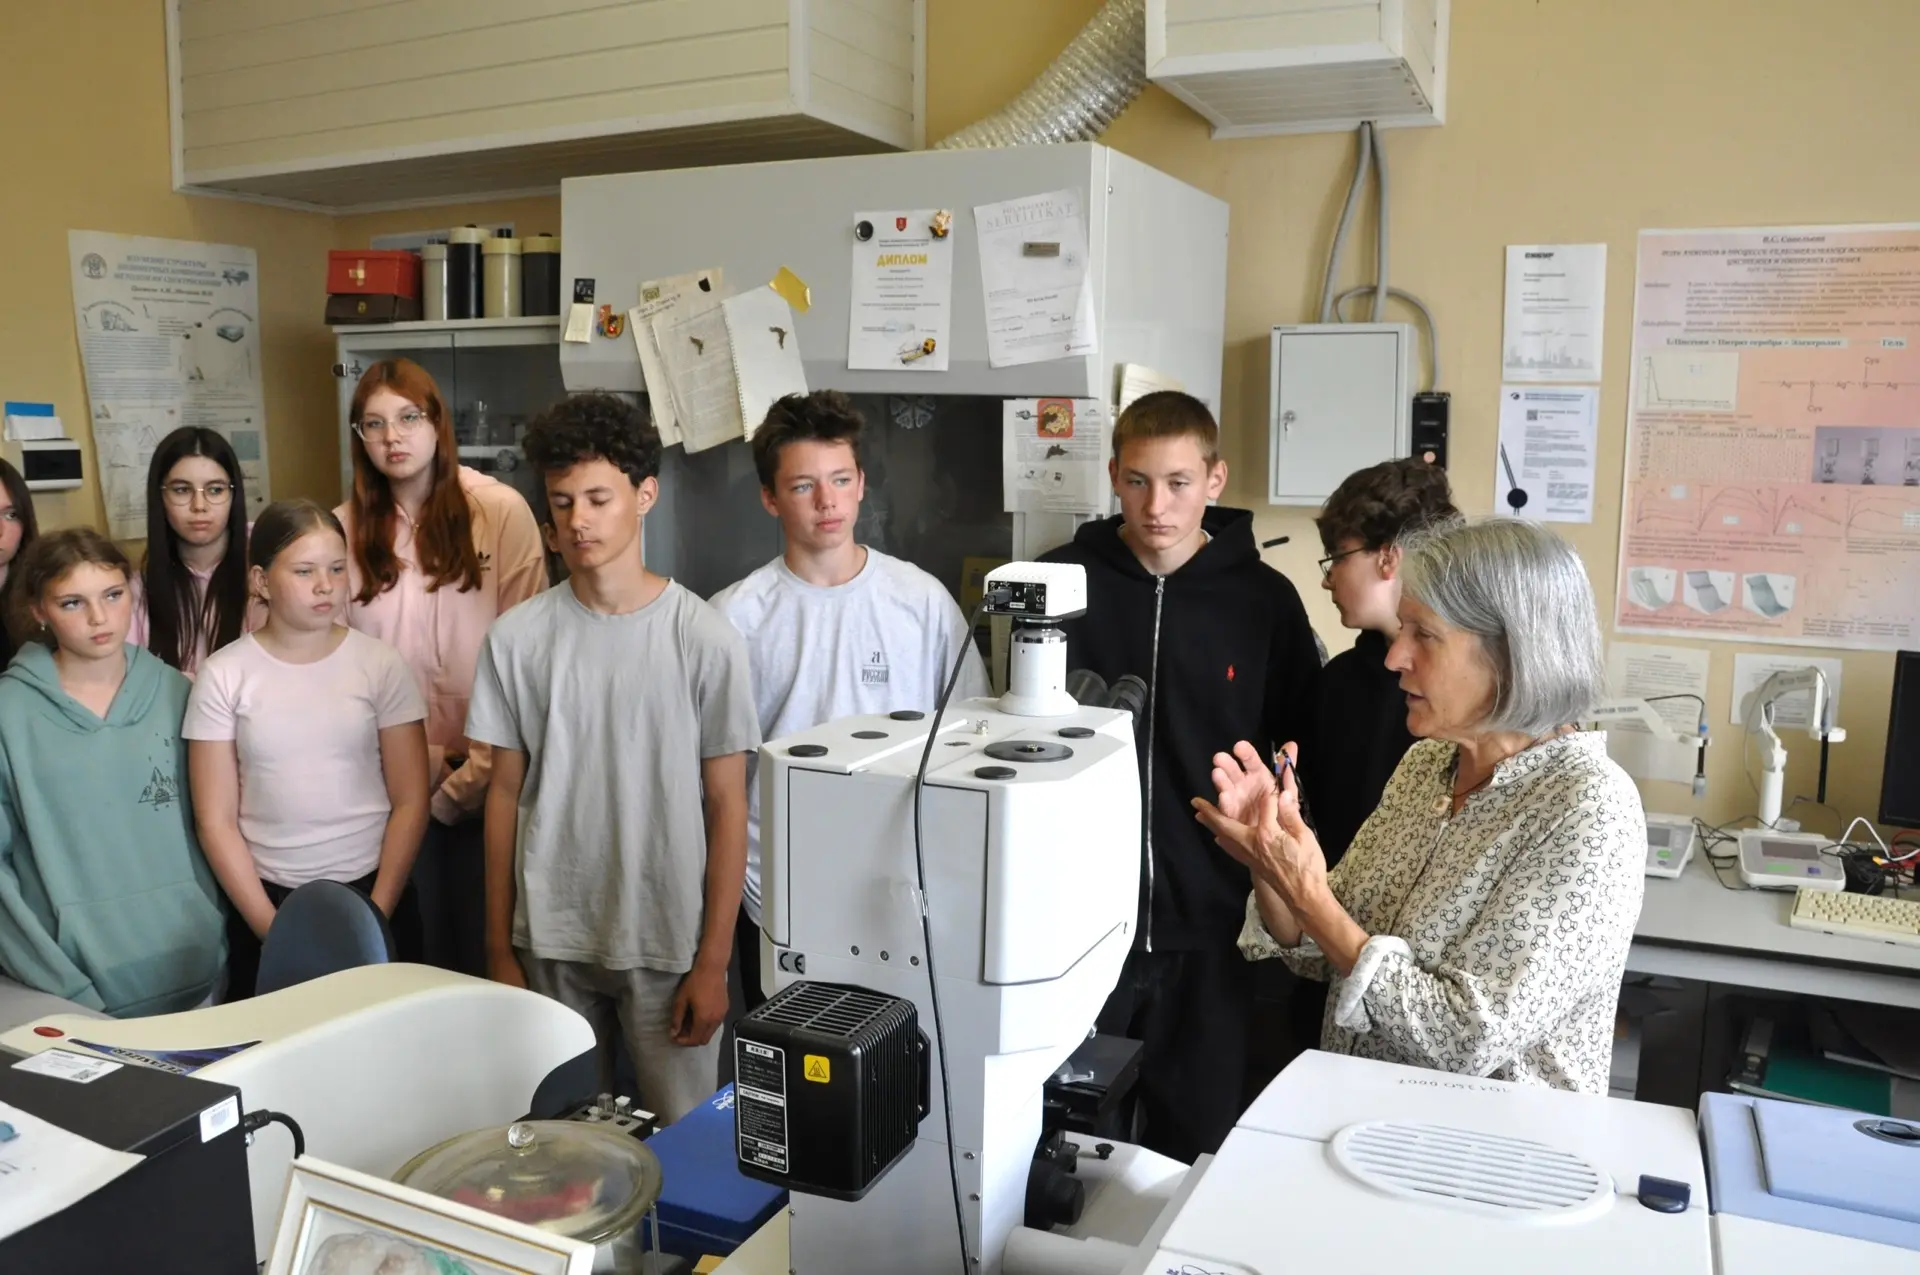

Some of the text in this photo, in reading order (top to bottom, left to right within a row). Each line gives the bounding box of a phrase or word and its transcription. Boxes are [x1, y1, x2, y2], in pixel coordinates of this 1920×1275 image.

[986, 202, 1074, 229] SERTIFIKAT
[877, 253, 928, 267] ДИПЛОМ
[1882, 339, 1905, 347] Гель
